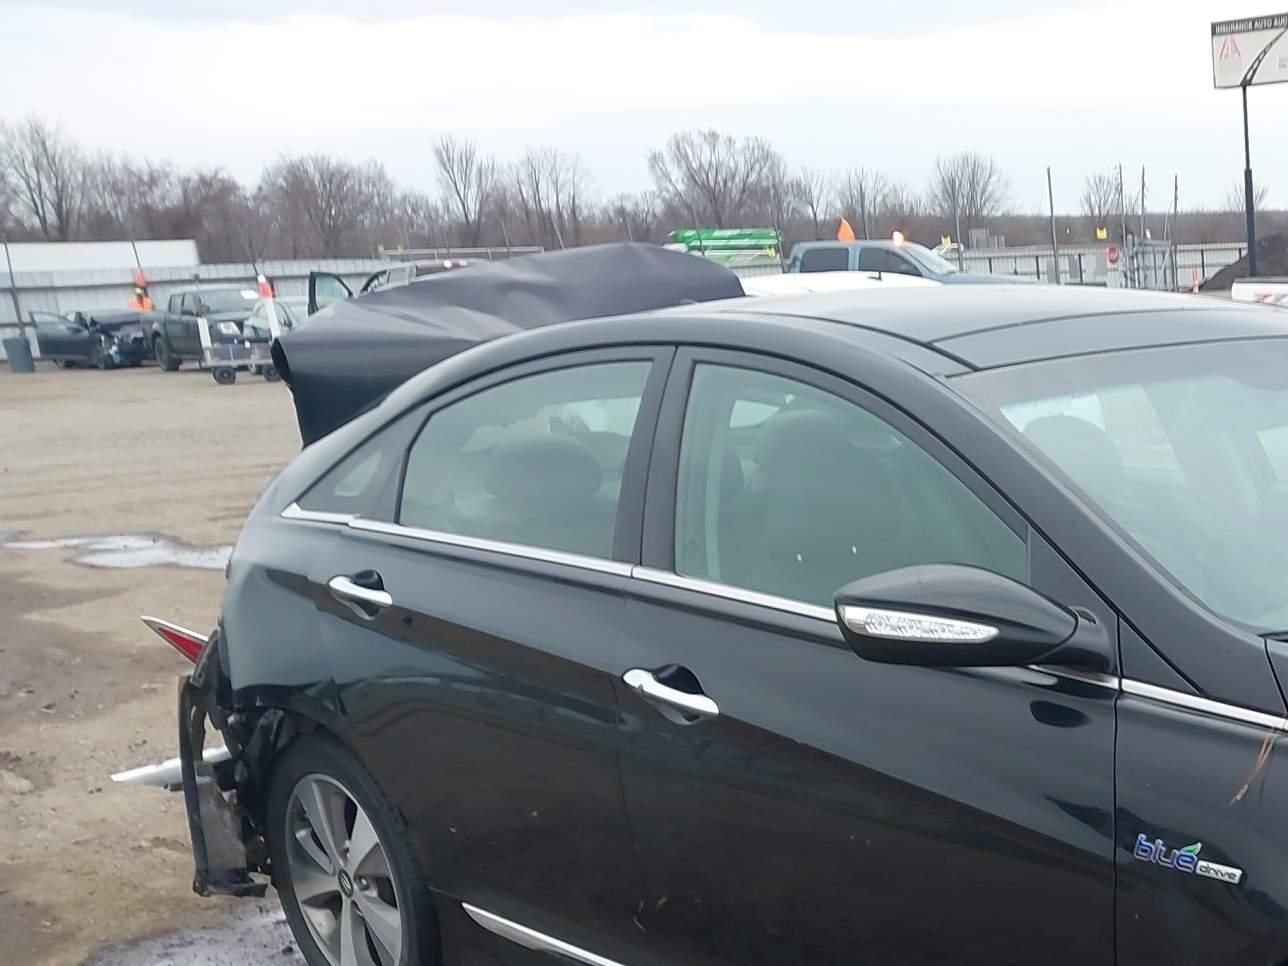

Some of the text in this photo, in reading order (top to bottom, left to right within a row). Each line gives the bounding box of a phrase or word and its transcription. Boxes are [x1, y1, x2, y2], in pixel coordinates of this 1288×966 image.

[1254, 19, 1272, 30] AUTO
[1133, 832, 1238, 881] blue drive
